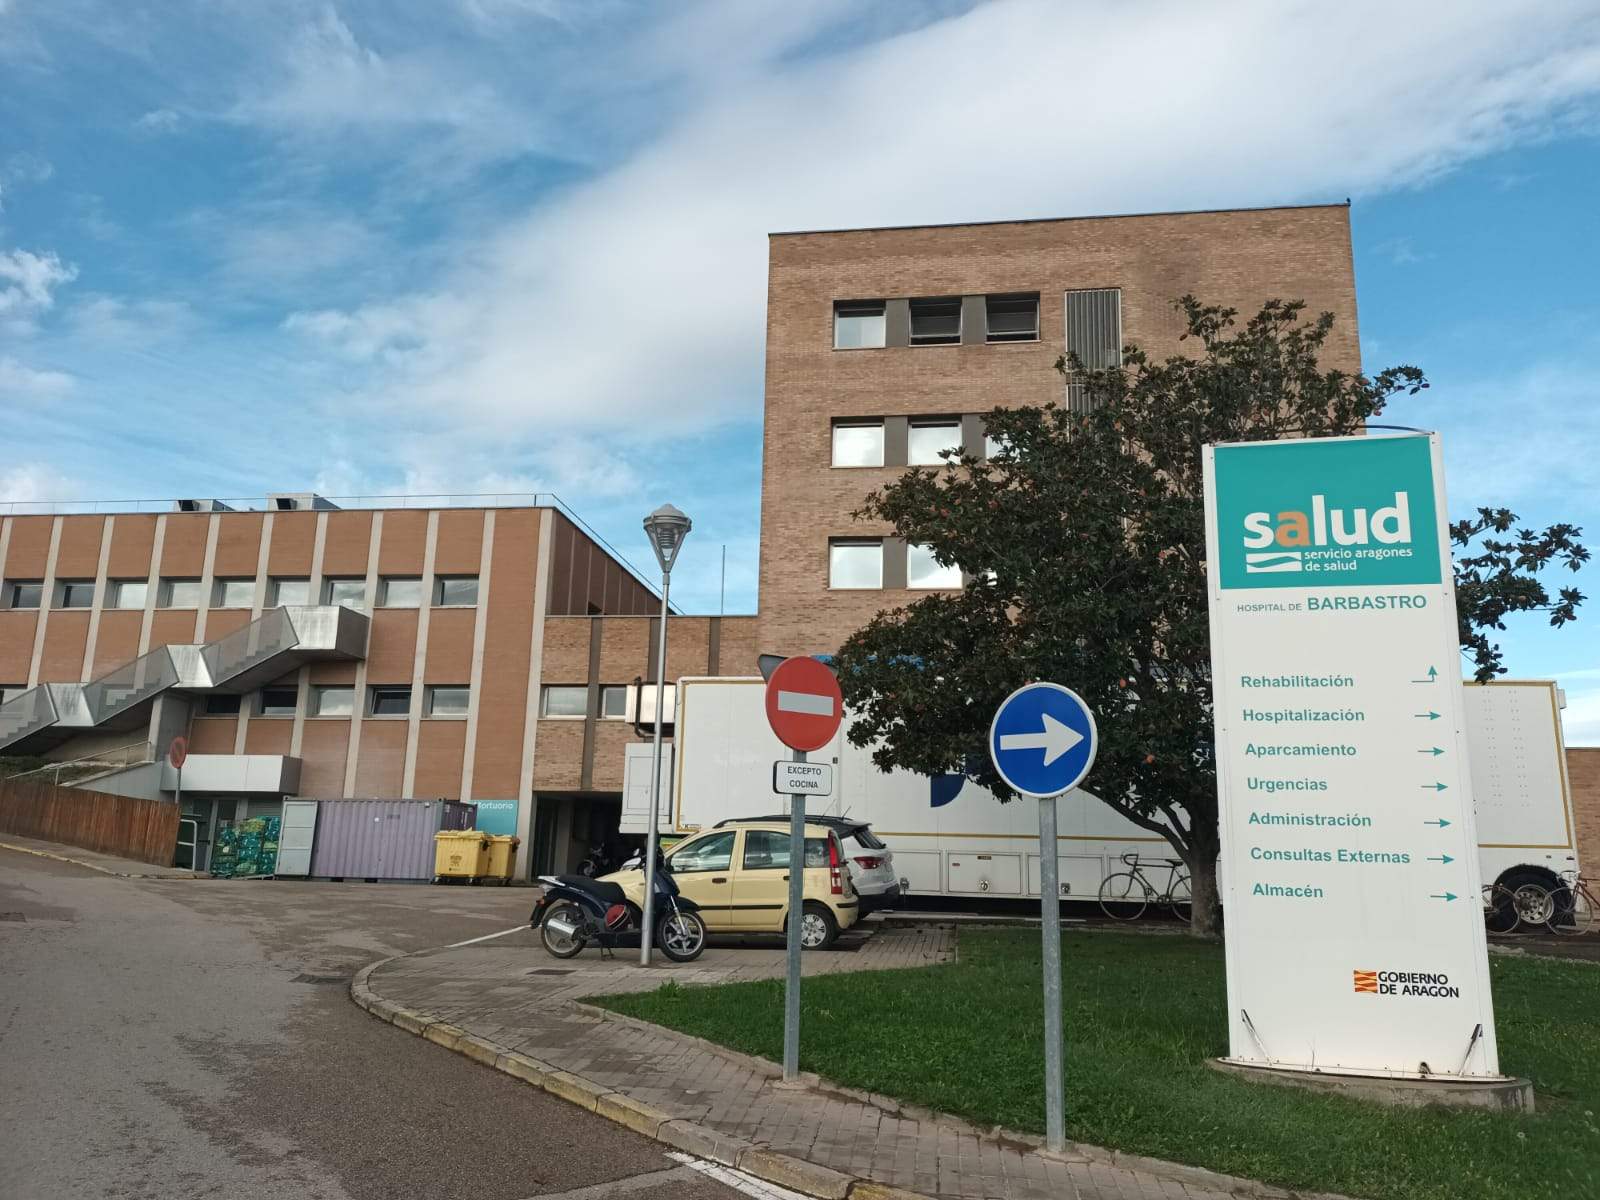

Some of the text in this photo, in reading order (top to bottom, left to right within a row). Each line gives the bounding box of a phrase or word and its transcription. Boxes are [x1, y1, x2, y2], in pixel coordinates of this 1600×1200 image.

[1243, 491, 1412, 549] salud
[1304, 547, 1412, 560] servicio aragones
[1305, 560, 1357, 571] de salud
[1237, 595, 1427, 612] HOSPITAL DE BARBASTRO
[1241, 674, 1354, 688] Rehabilitación
[1243, 708, 1365, 724] Hospitalización
[1245, 743, 1357, 759] Aparcamiento
[787, 765, 822, 775] EXCEPTO
[789, 780, 818, 788] COCINA
[1247, 777, 1328, 793] Urgencias
[1248, 811, 1372, 827] Administración
[1250, 846, 1410, 864] Consultas Externas
[1252, 883, 1324, 898] Almacén
[1378, 971, 1449, 985] GOBIERNO
[1379, 984, 1459, 998] DE ARAGON
